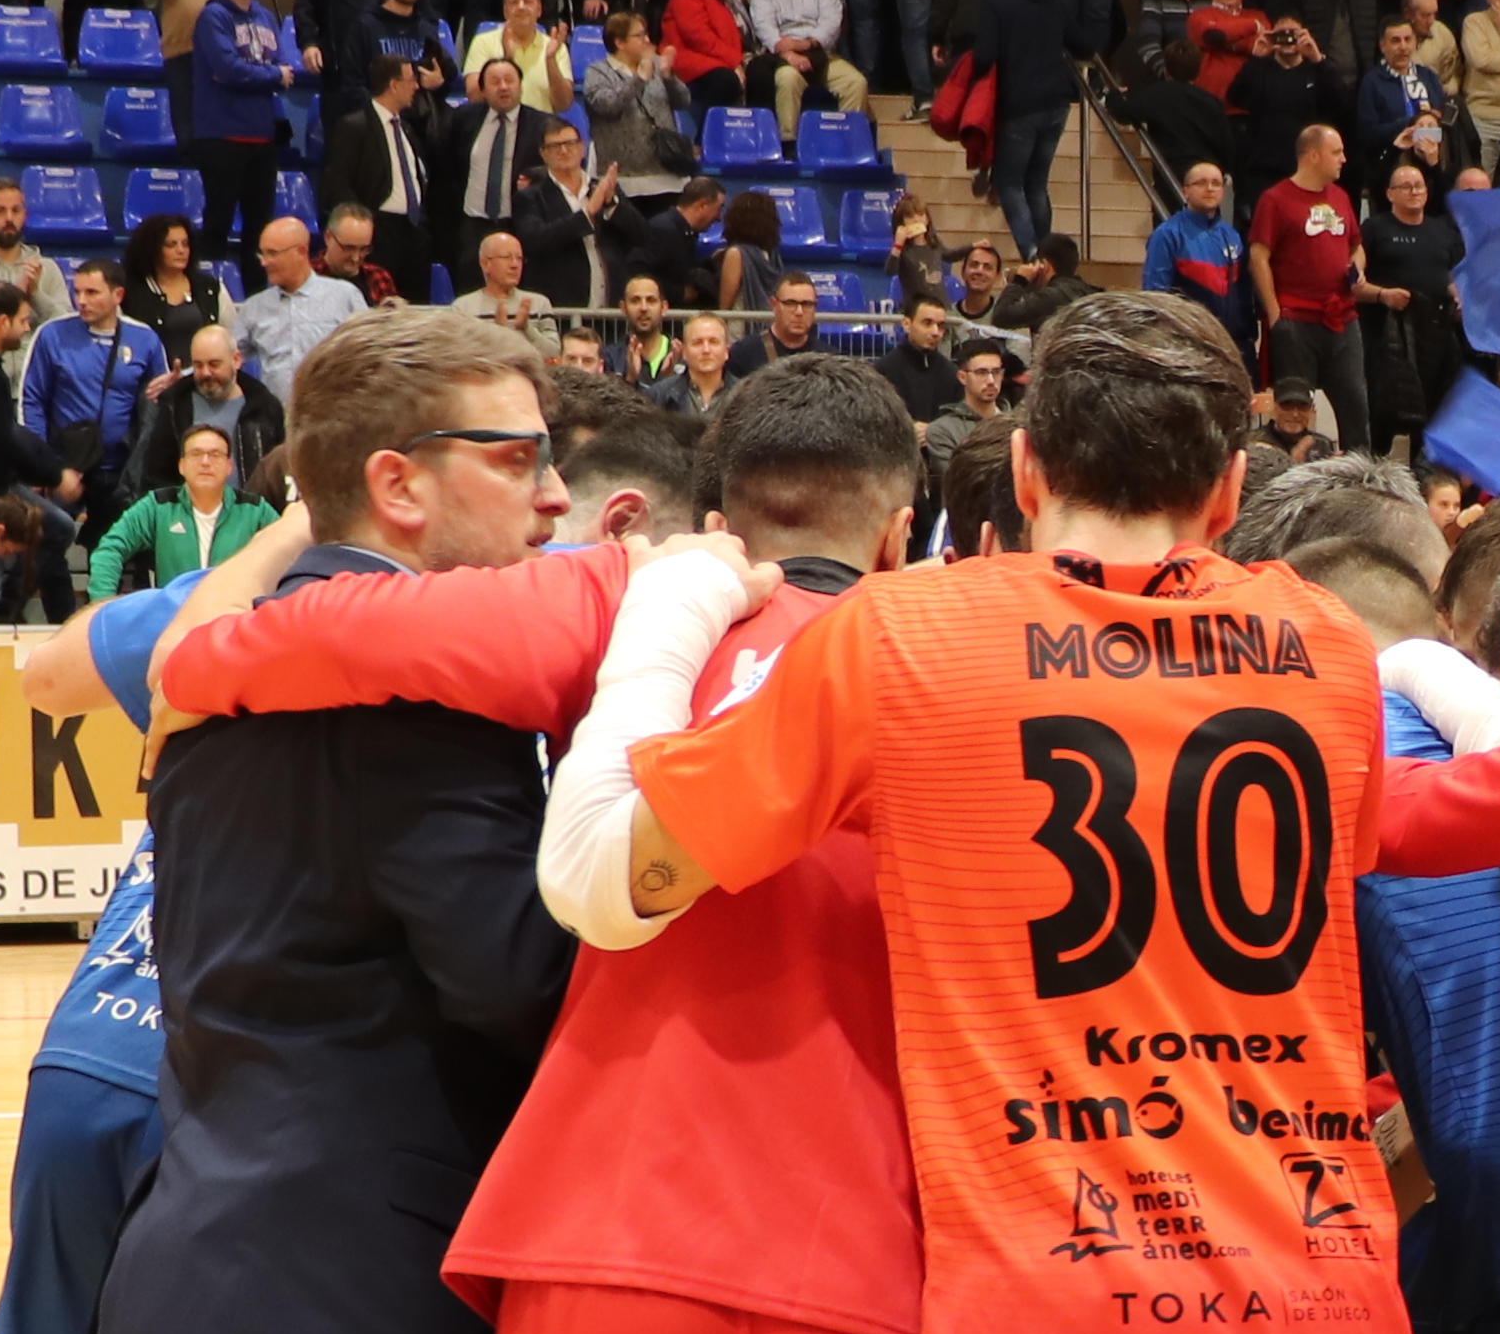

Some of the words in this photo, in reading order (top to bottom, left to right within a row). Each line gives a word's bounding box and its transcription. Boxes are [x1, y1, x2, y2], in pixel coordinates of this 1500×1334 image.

[1025, 613, 1318, 681] MOLINA
[1018, 705, 1333, 1000] 30
[23, 867, 77, 900] DE
[1084, 1024, 1308, 1067] Kromex
[1004, 1068, 1185, 1147] simó
[1305, 1235, 1375, 1257] HOTEL
[1111, 1290, 1273, 1325] TOKA
[1289, 1286, 1347, 1304] SALÓN
[1293, 1307, 1318, 1322] DE
